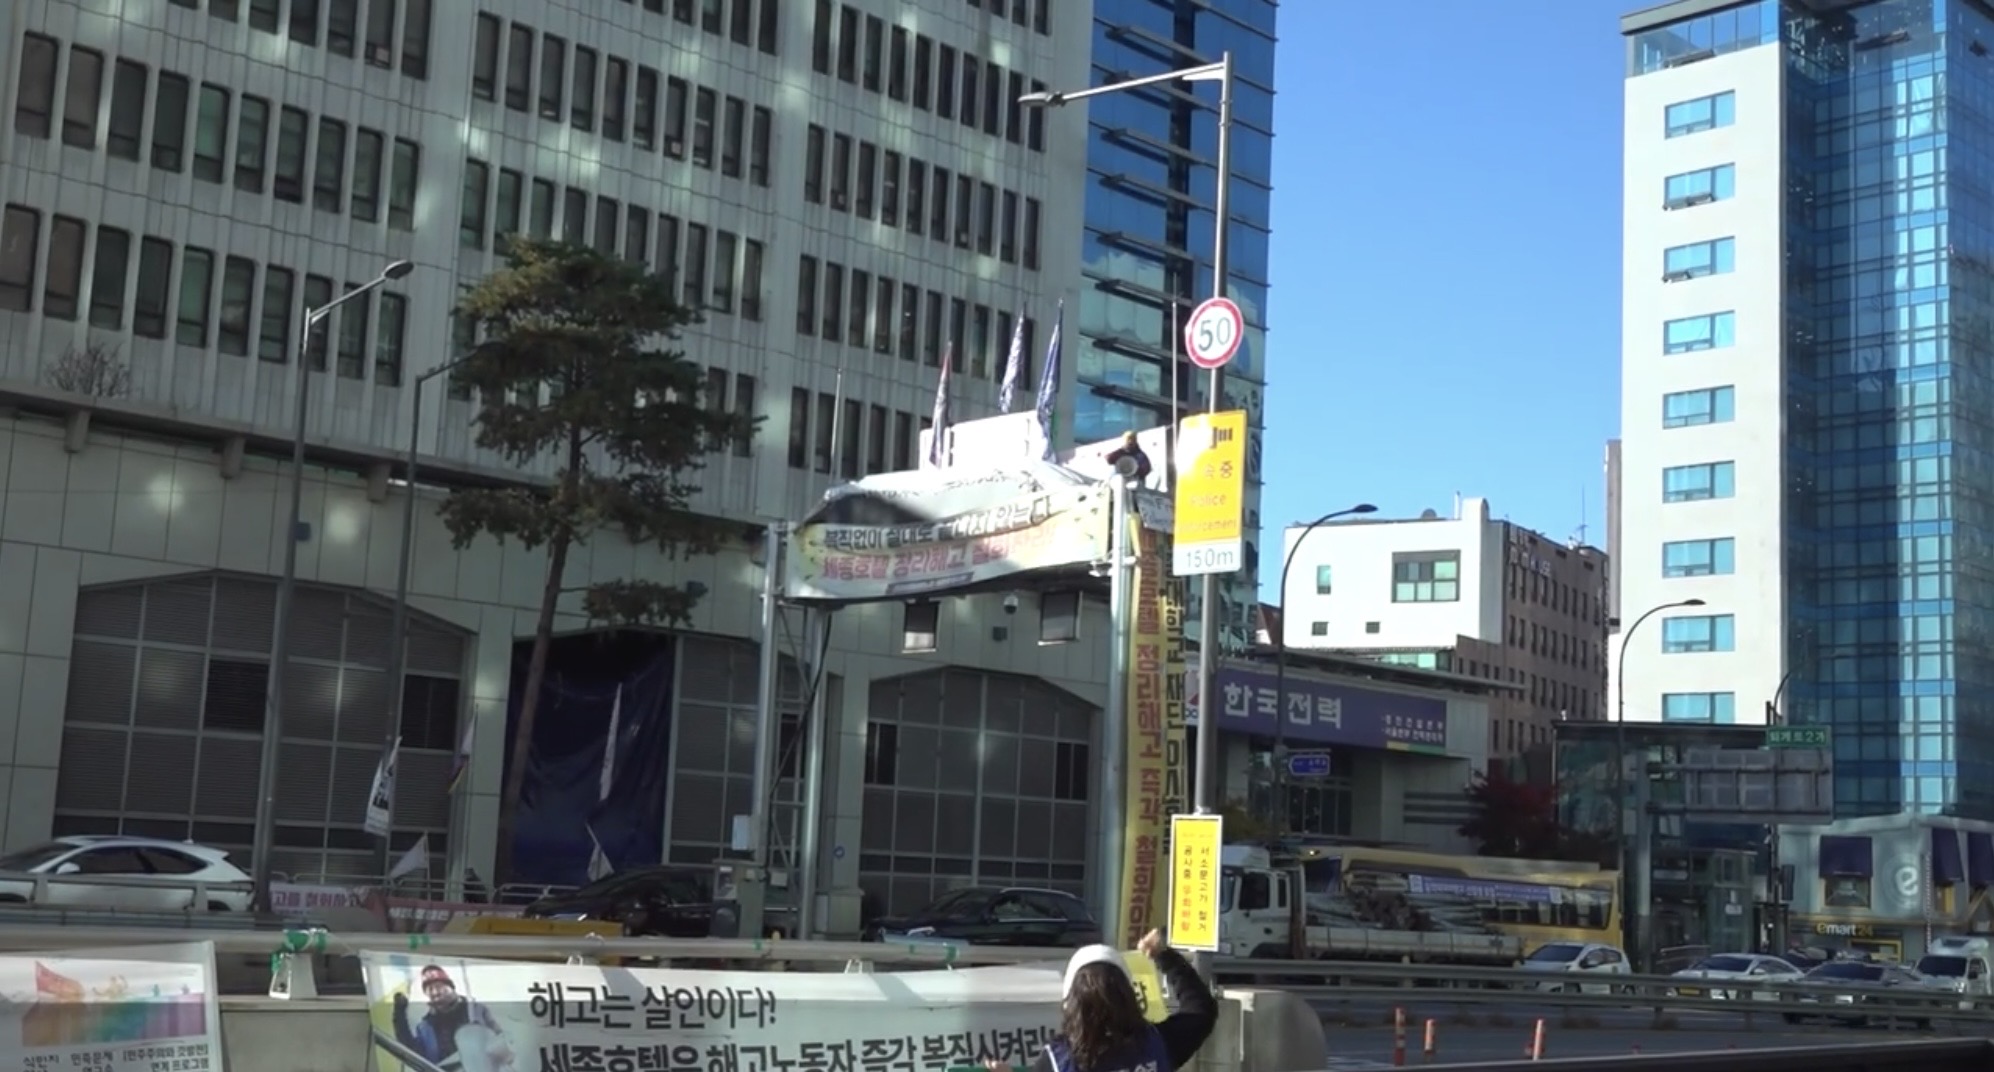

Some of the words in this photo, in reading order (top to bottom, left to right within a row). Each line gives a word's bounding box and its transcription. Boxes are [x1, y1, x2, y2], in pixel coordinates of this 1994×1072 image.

[1198, 316, 1232, 352] 50
[1185, 548, 1234, 569] 150m
[1224, 683, 1342, 729] 한국전력
[528, 982, 635, 1029] 해고는
[642, 985, 777, 1029] 살인이다!
[539, 1043, 704, 1072] 세종호텔은
[706, 1039, 858, 1072] 해고노동자
[861, 1035, 917, 1072] 즉각
